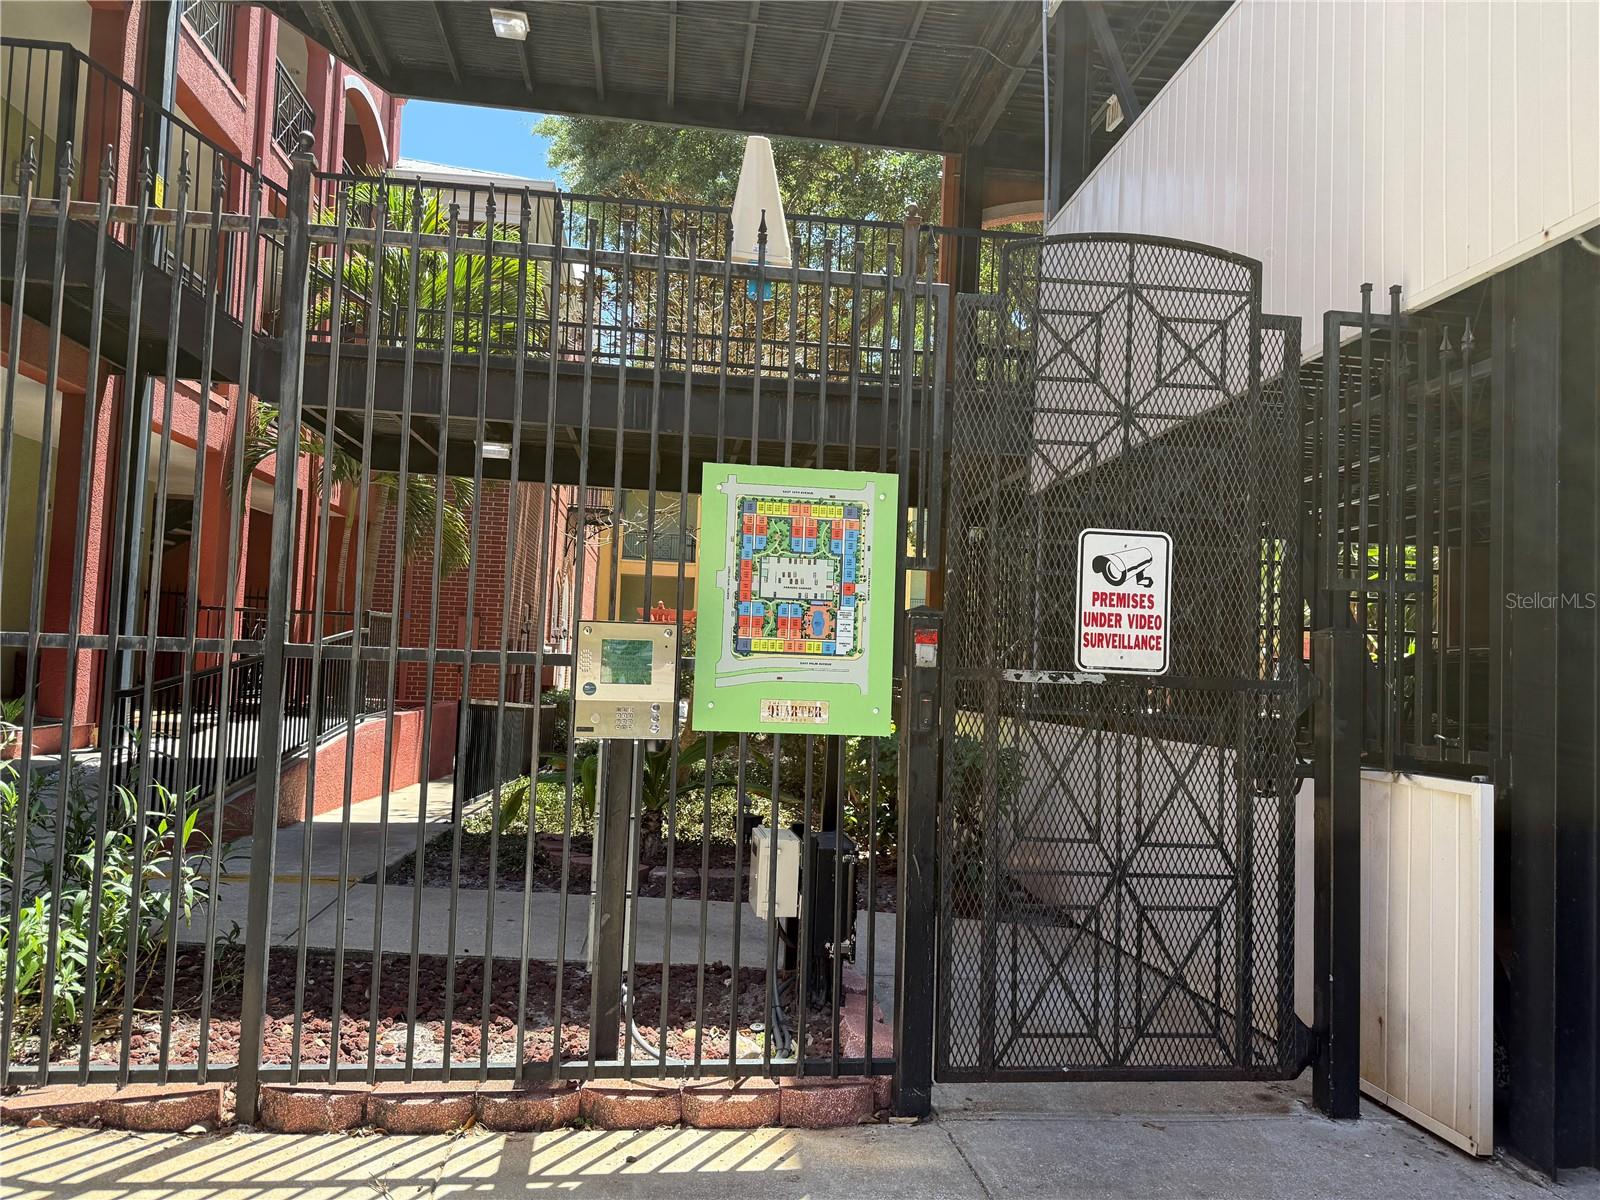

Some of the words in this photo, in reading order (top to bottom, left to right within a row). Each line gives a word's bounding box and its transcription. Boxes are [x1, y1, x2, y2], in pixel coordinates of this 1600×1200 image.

[1092, 592, 1154, 609] PREMISES
[1083, 611, 1122, 629] UNDER
[1127, 613, 1162, 630] VIDEO
[1083, 632, 1162, 651] SURVEILLANCE
[767, 705, 822, 718] QUARTER
